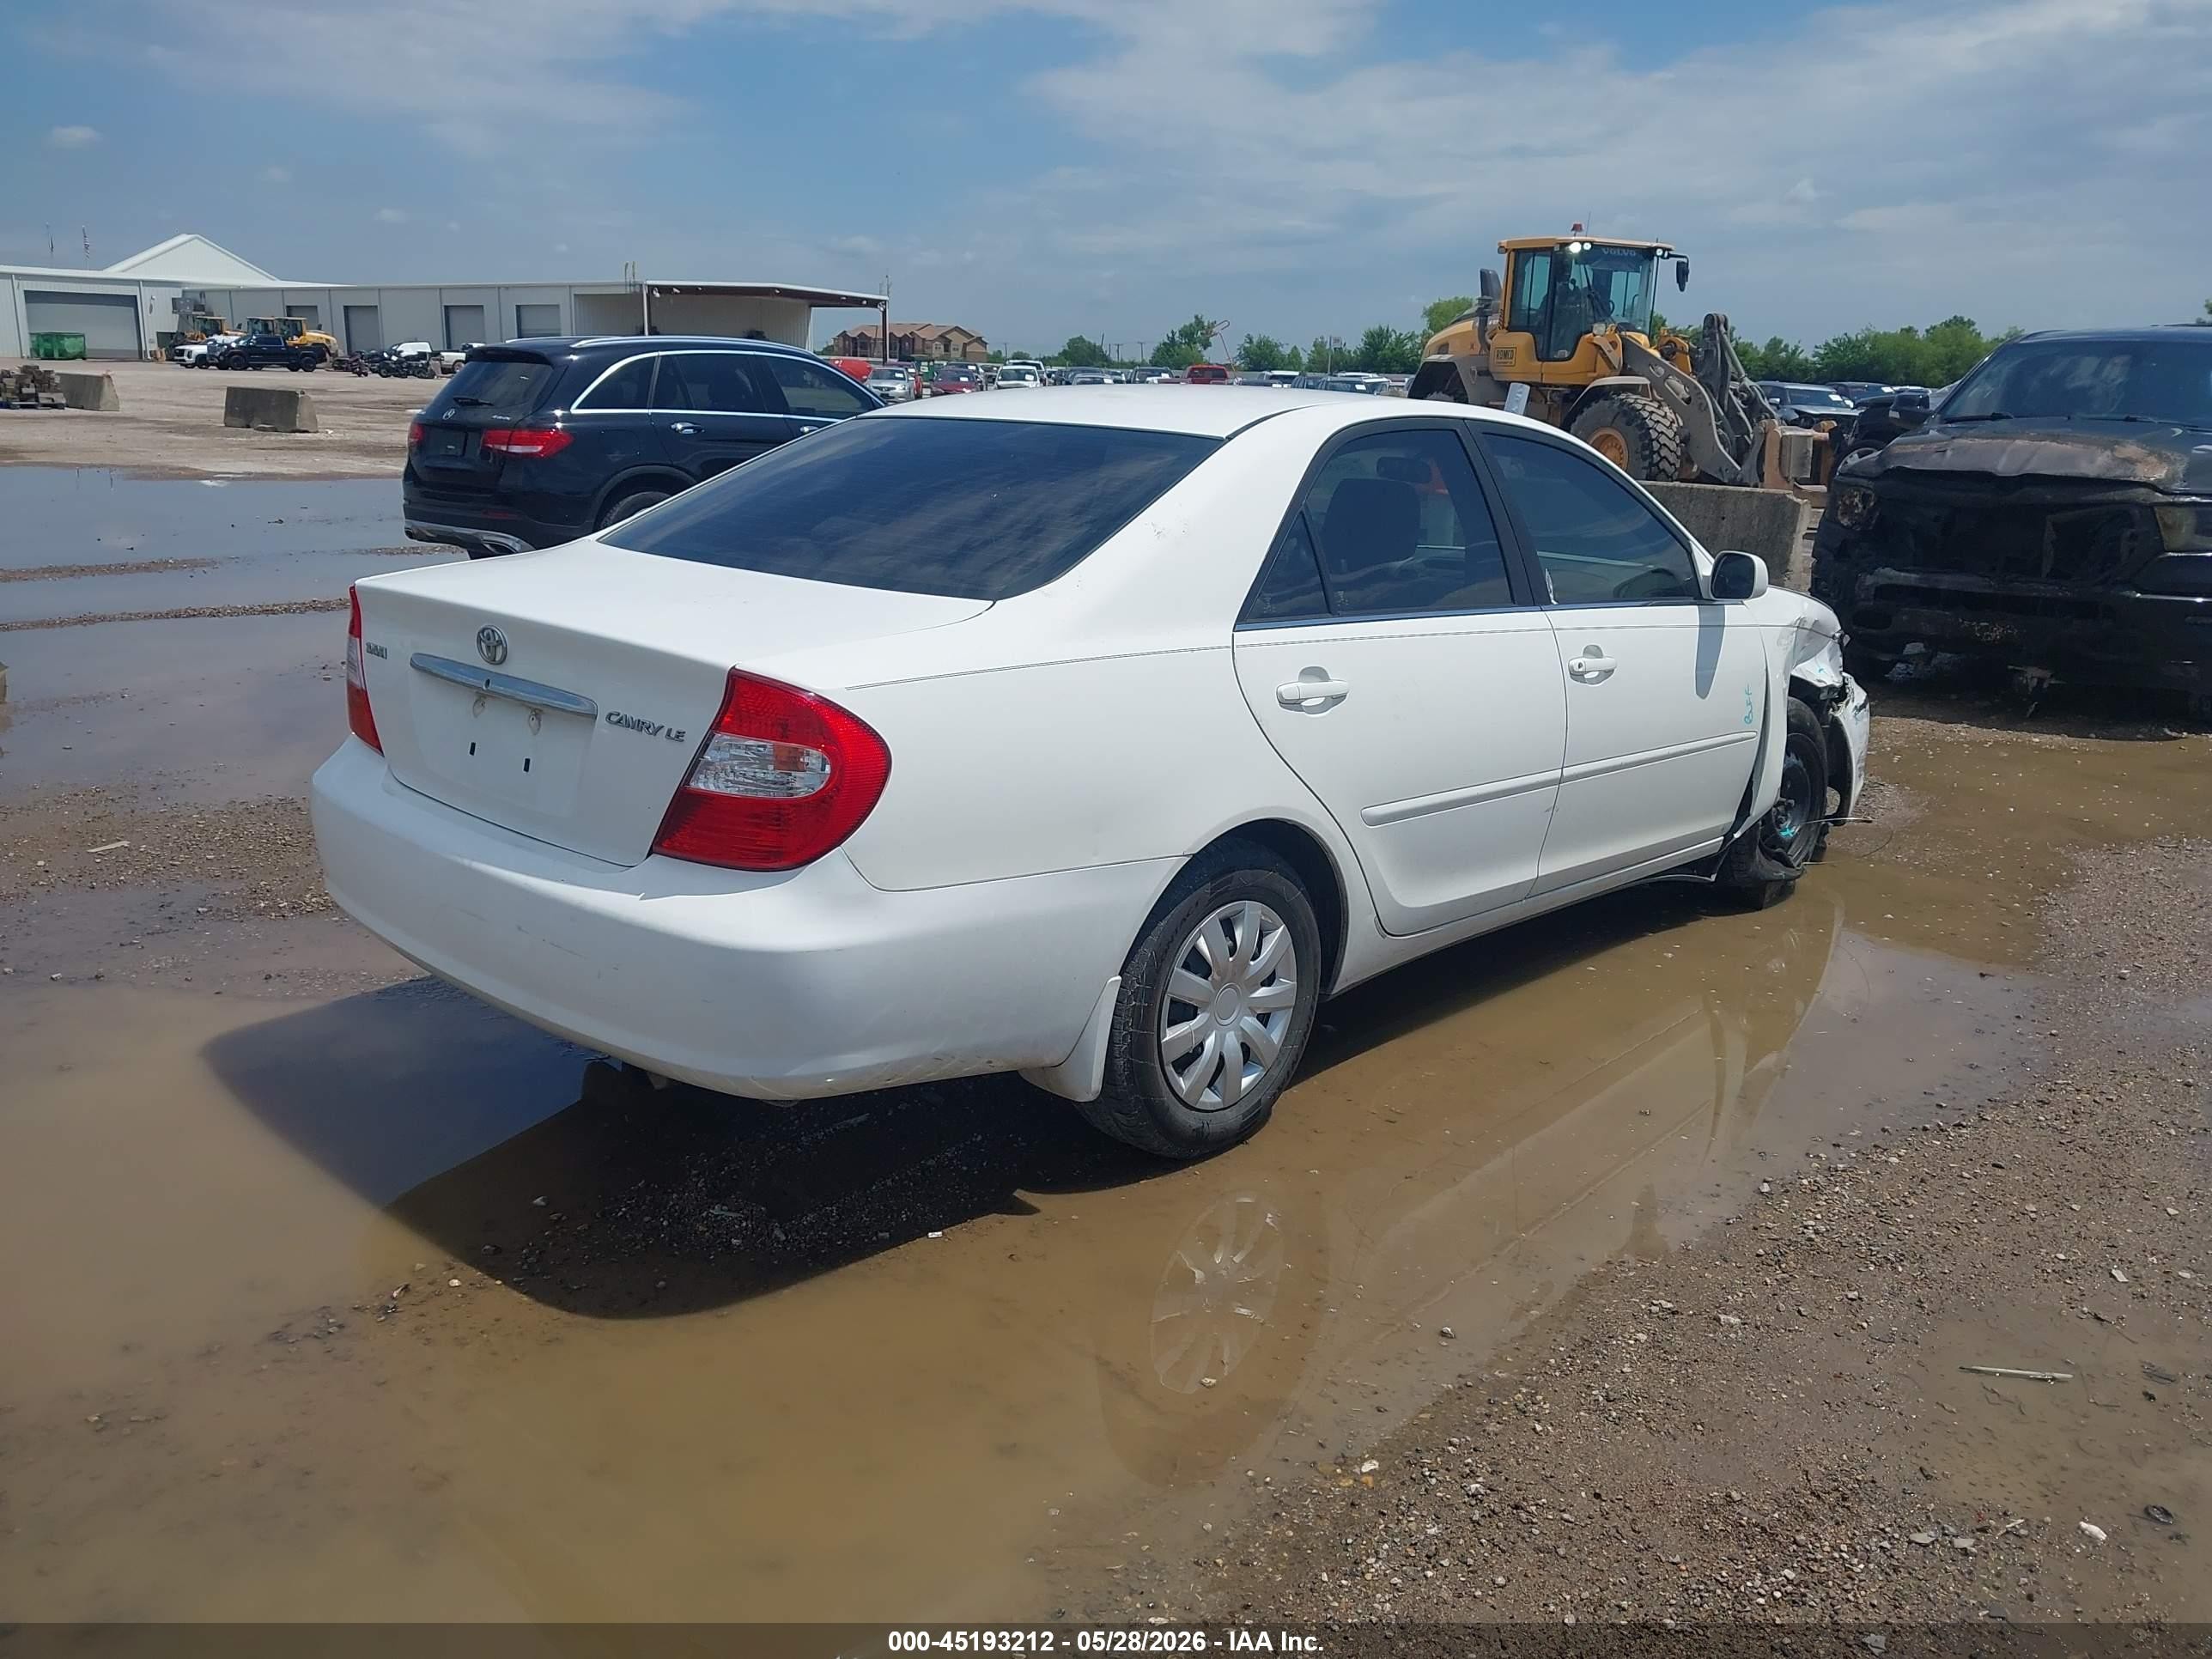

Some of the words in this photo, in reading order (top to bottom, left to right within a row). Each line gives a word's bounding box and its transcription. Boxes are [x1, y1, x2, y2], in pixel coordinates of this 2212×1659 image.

[1601, 246, 1637, 257] VOLVO
[605, 711, 665, 737] CAMRY
[665, 727, 686, 743] LE
